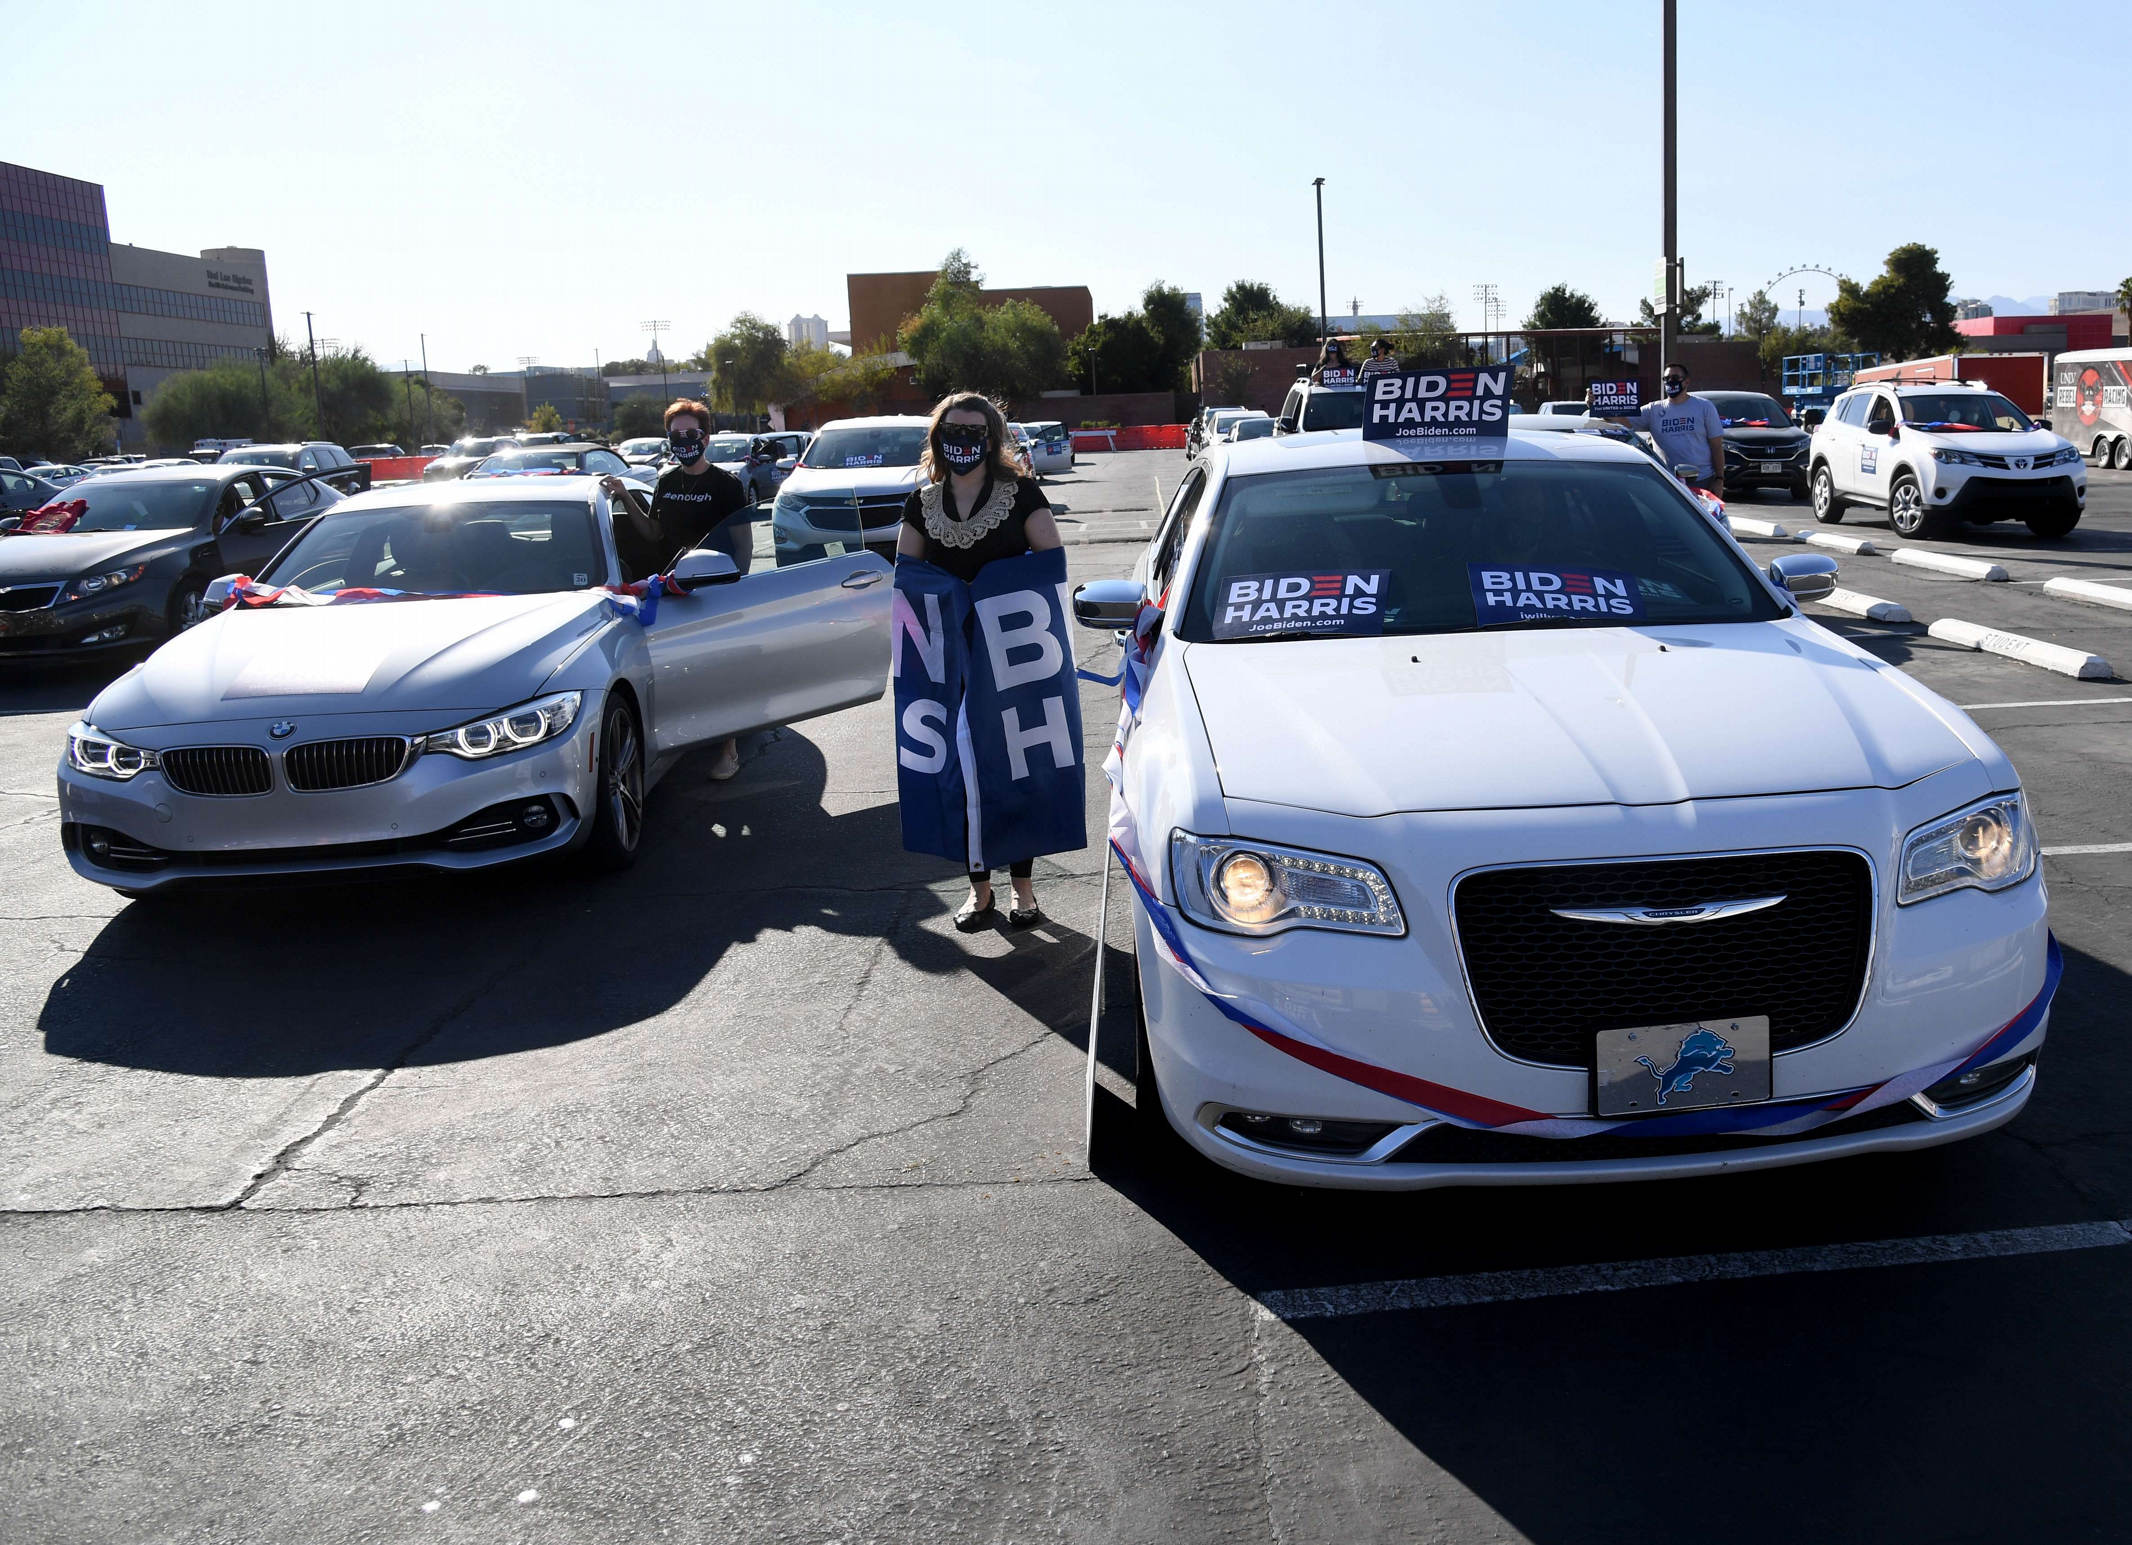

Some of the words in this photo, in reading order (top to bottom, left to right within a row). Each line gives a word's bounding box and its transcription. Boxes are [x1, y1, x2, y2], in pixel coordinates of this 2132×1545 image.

[1323, 368, 1354, 378] BIDEN
[1323, 376, 1354, 385] HARRIS
[1374, 371, 1507, 400] BIDEN
[1592, 382, 1637, 395] BIDEN
[1592, 395, 1638, 405] HARRIS
[1372, 399, 1503, 423] HARRIS
[1662, 417, 1695, 426] BIDEN
[1395, 426, 1476, 436] JoeBiden.com
[1661, 424, 1695, 433] HARRIS
[943, 443, 981, 456] BIDEN
[846, 454, 883, 462] BIDEN
[943, 453, 981, 464] HARRIS
[663, 492, 712, 502] #enough
[1228, 575, 1380, 603] BIDEN
[1481, 571, 1628, 597] BIDEN
[1485, 591, 1634, 615] HARRIS
[1224, 597, 1377, 624] HARRIS
[1249, 618, 1344, 632] JoeBiden.com
[900, 698, 947, 774] S
[1000, 695, 1076, 781] H
[1648, 909, 1699, 918] CHRYSLER
